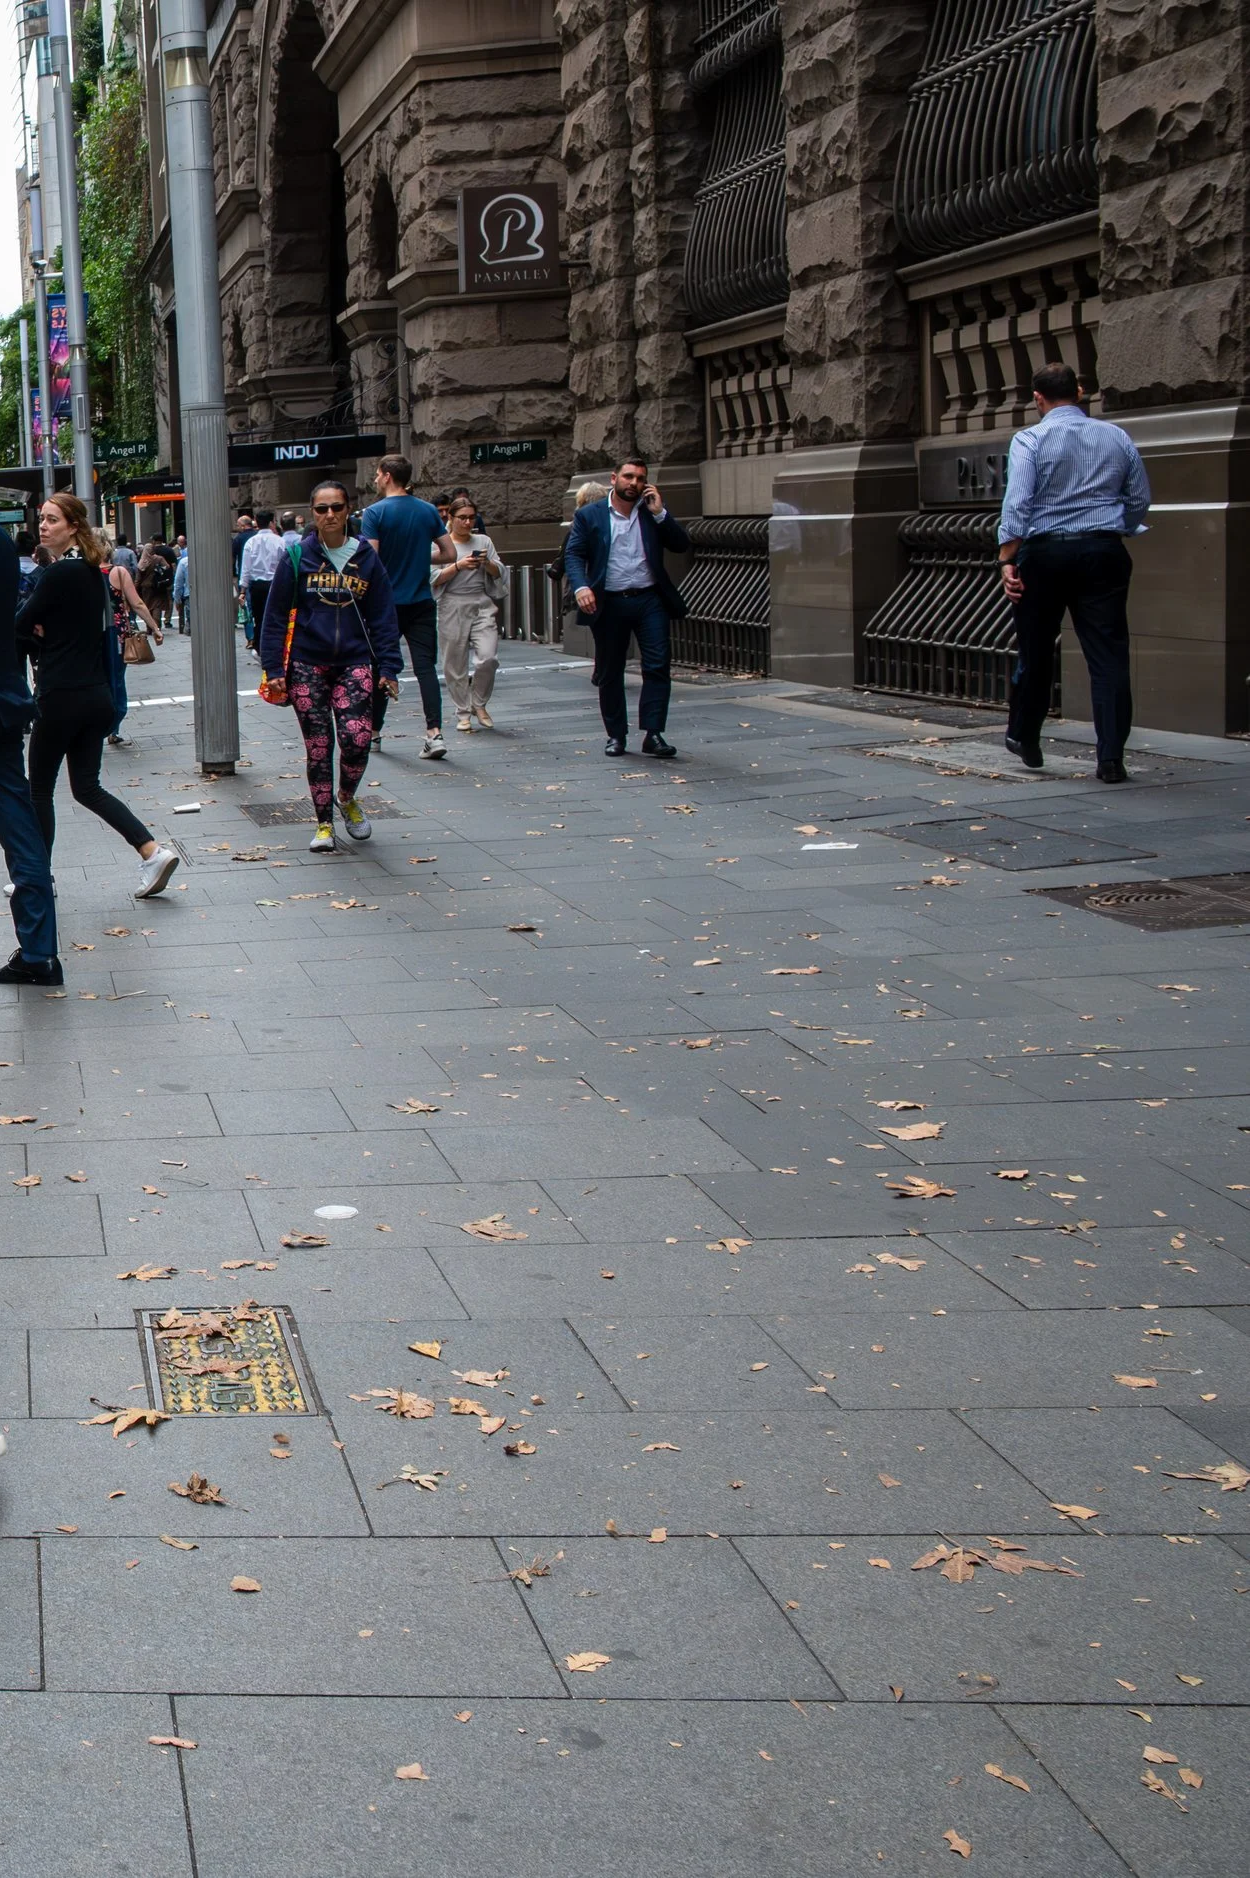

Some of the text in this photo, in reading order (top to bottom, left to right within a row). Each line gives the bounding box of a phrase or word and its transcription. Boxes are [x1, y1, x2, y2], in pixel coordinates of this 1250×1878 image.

[473, 268, 551, 284] PASPALEY
[109, 443, 147, 457] Angel Pl
[275, 444, 319, 460] INDU
[492, 442, 532, 456] Angel Pl
[306, 570, 370, 596] PRINCE
